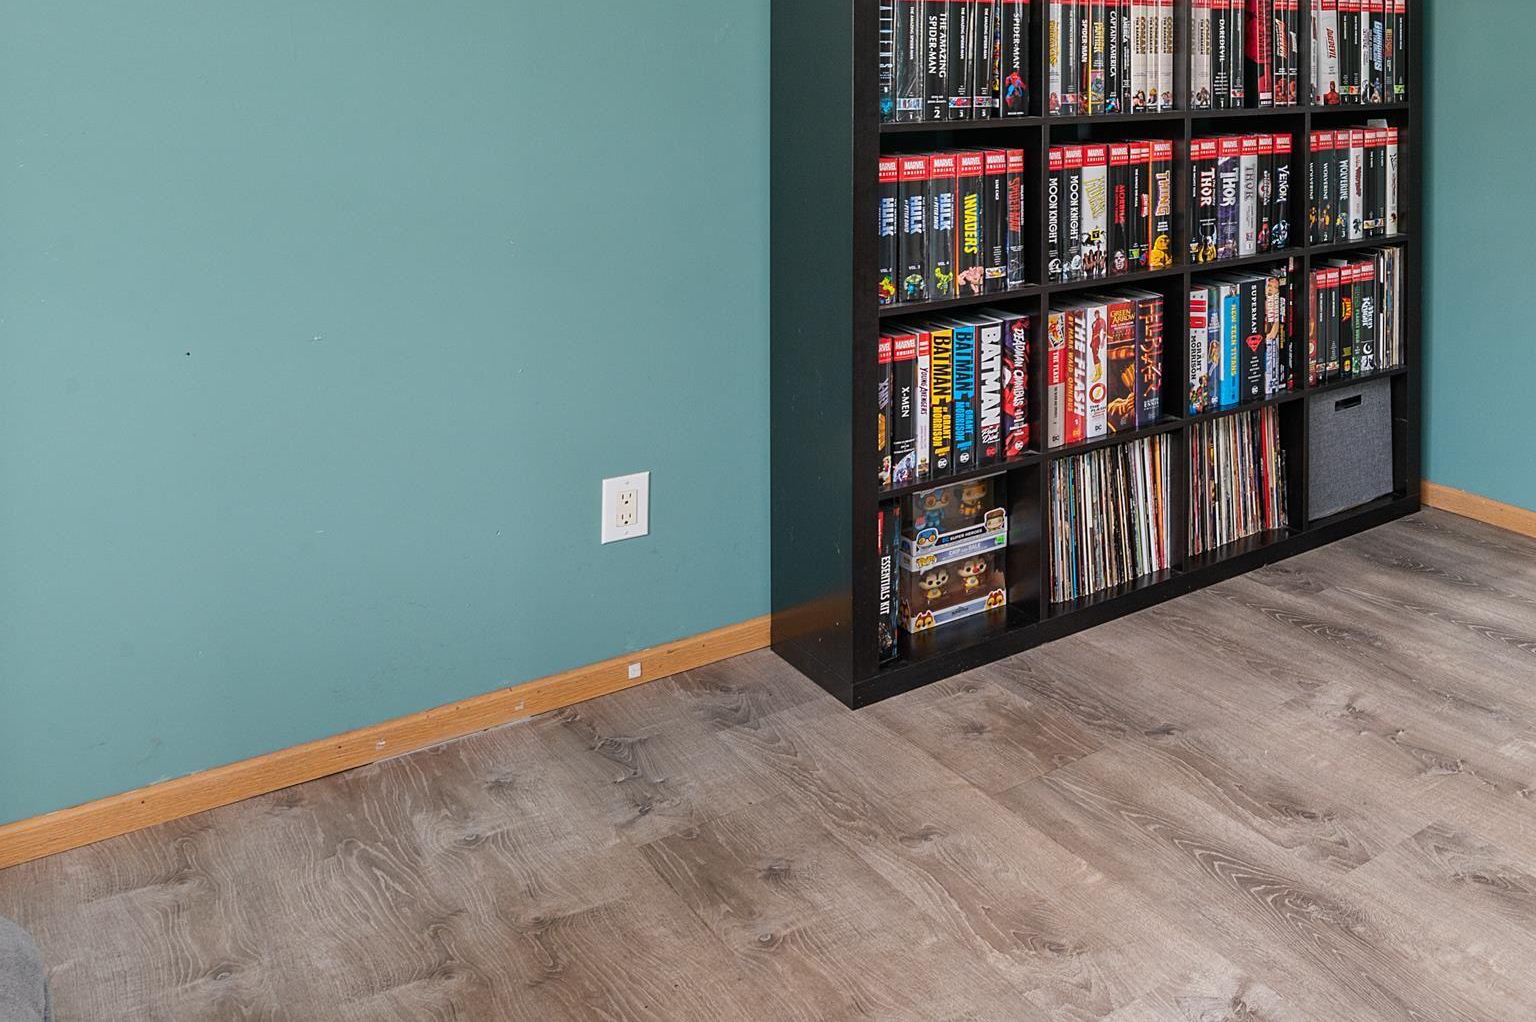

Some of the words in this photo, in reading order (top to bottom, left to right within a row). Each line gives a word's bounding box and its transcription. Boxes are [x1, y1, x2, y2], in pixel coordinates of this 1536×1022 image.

[928, 16, 937, 74] SPIDER-MAN
[1012, 13, 1020, 69] SPIDER-MAN
[934, 110, 941, 118] 2
[904, 160, 925, 170] MARVEL
[1245, 166, 1254, 200] THOR
[1275, 165, 1289, 203] VENOM
[1340, 160, 1349, 200] WOLVERINE
[1008, 177, 1020, 232] SPIDER-MAN
[1048, 178, 1057, 209] MOON
[1070, 176, 1079, 206] MOON
[1155, 170, 1170, 216] THING
[1200, 167, 1215, 207] THOR
[1220, 168, 1239, 207] THOR
[881, 197, 894, 236] HULK
[909, 196, 922, 234] HULK
[939, 193, 951, 231] HULK
[963, 193, 978, 254] INVADERS
[1048, 210, 1057, 243] KNIGHT
[1070, 207, 1079, 240] KNIGHT
[1110, 309, 1131, 318] GREEN
[1112, 313, 1135, 324] ARROW
[895, 339, 915, 349] MARVEL
[1013, 328, 1026, 367] DEADMAN
[1074, 317, 1086, 351] THE
[919, 367, 928, 386] YOUNG
[933, 336, 951, 396] BATMAN
[955, 331, 973, 391] BATMAN
[981, 326, 1001, 427] BATMAN
[901, 387, 910, 418] X-MEN
[919, 386, 928, 415] AVENGERS
[1013, 370, 1026, 407] OMNIBUS
[1074, 358, 1086, 416] FLASH
[932, 407, 943, 447] MORRISON
[943, 414, 951, 439] GRANT
[955, 402, 965, 441] MORRISON
[965, 410, 973, 435] GRANT
[1094, 424, 1102, 432] DC
[880, 555, 891, 600] ESSENTIALS
[880, 600, 891, 615] KIT
